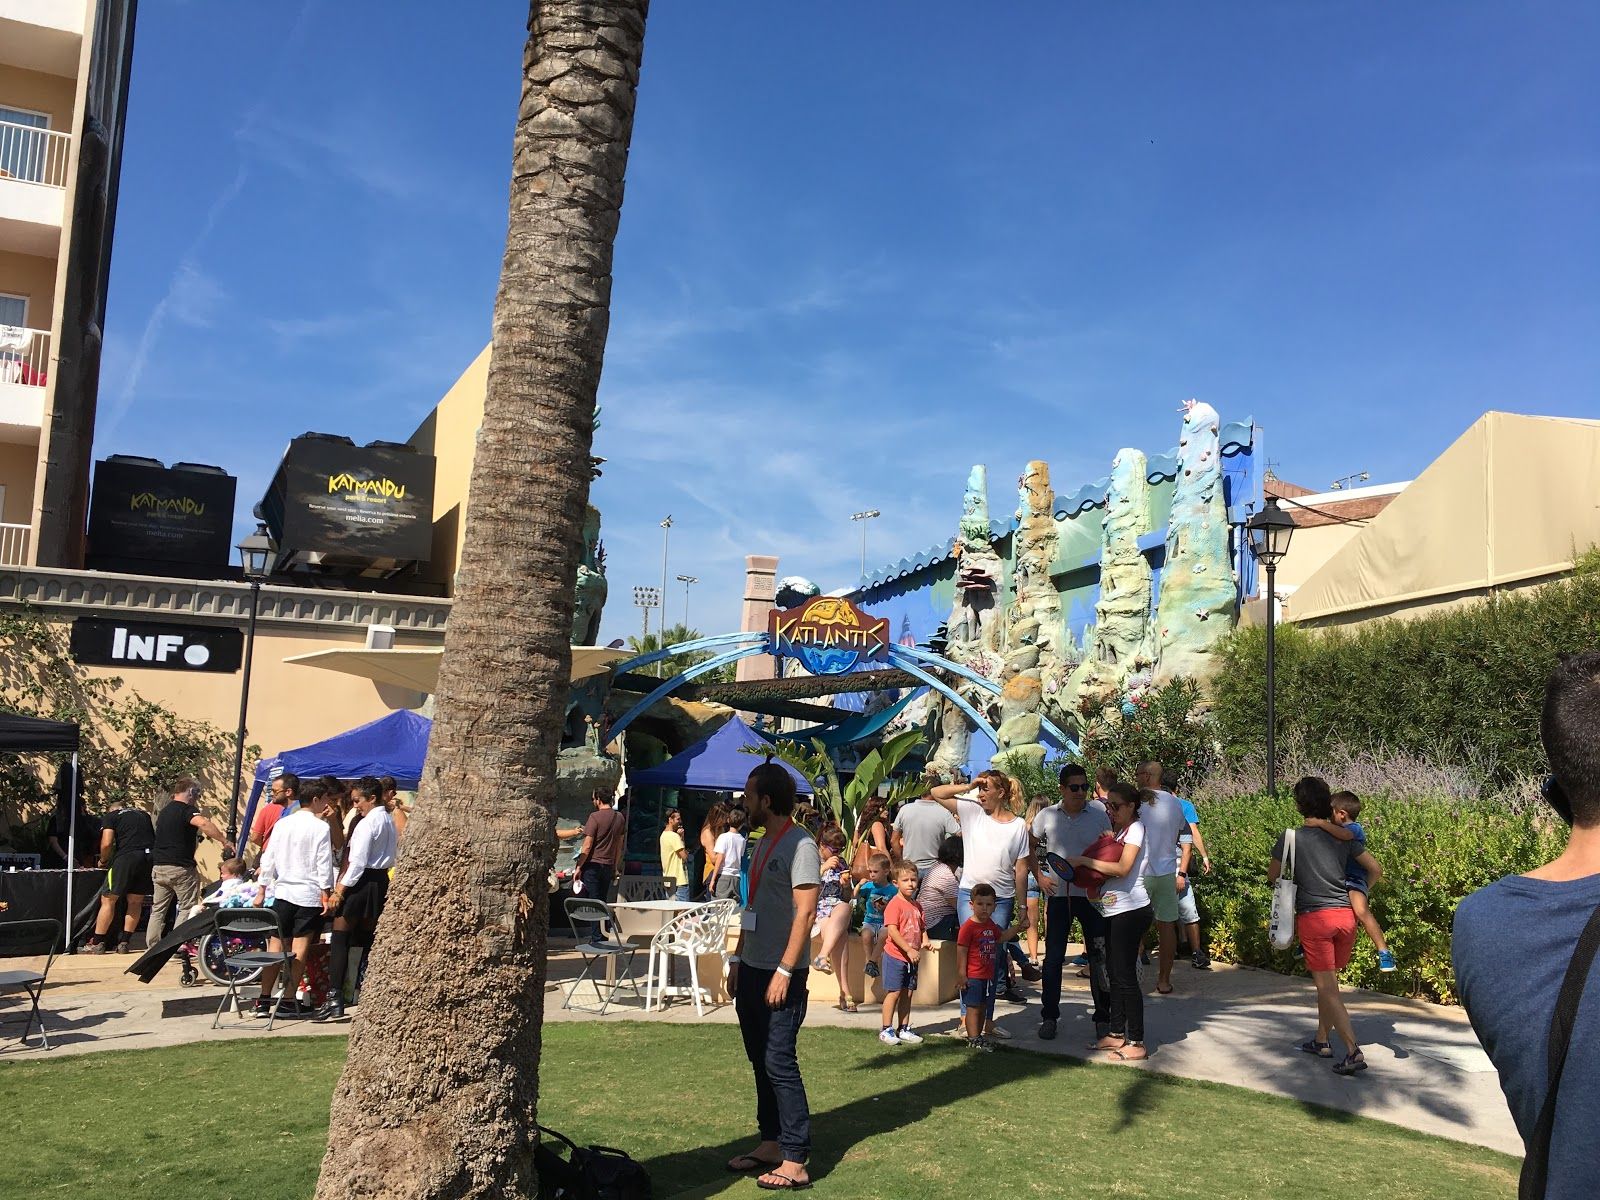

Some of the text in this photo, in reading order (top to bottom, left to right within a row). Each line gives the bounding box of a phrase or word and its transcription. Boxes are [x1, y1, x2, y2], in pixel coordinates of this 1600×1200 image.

[329, 473, 405, 499] KATMANDU
[130, 492, 205, 516] KATMANDU
[345, 514, 384, 525] melia.com
[112, 627, 210, 665] INFO
[775, 616, 885, 657] KATLANTIS
